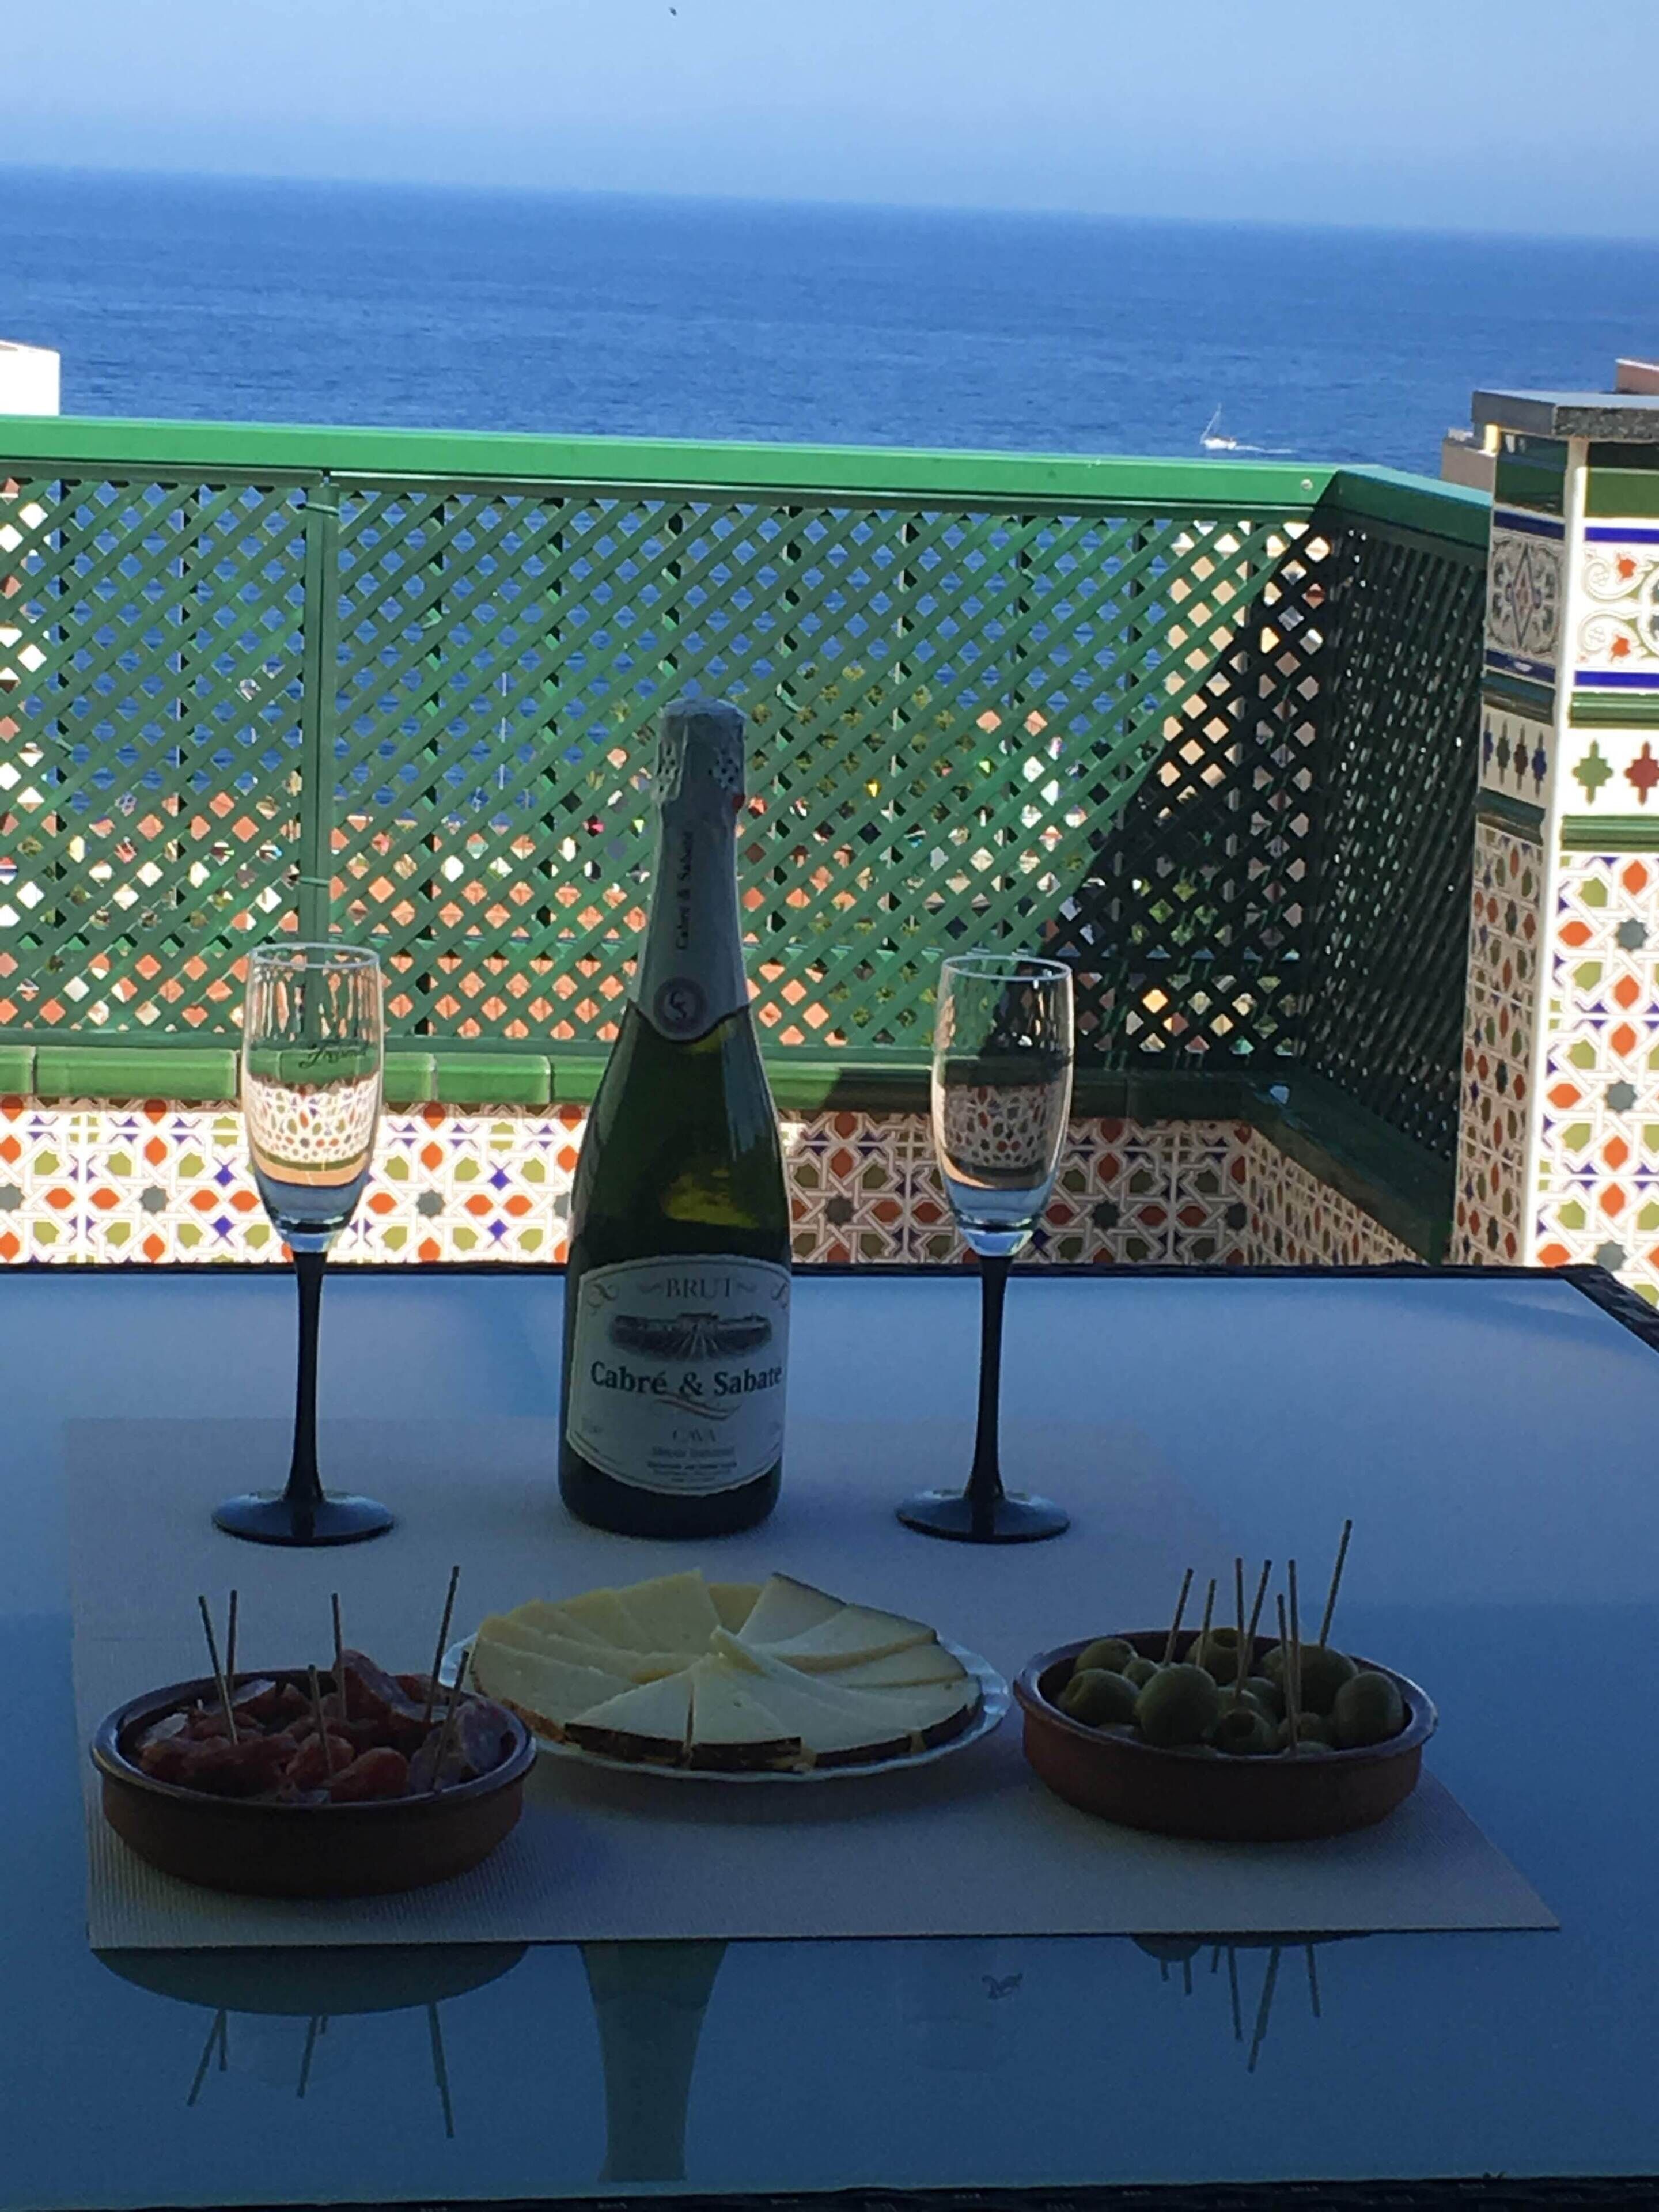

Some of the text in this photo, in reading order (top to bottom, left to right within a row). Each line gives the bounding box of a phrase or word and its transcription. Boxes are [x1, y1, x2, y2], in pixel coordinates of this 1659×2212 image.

[666, 1278, 731, 1298] BRUT
[591, 1361, 667, 1395] Cabré
[679, 1372, 703, 1396] &
